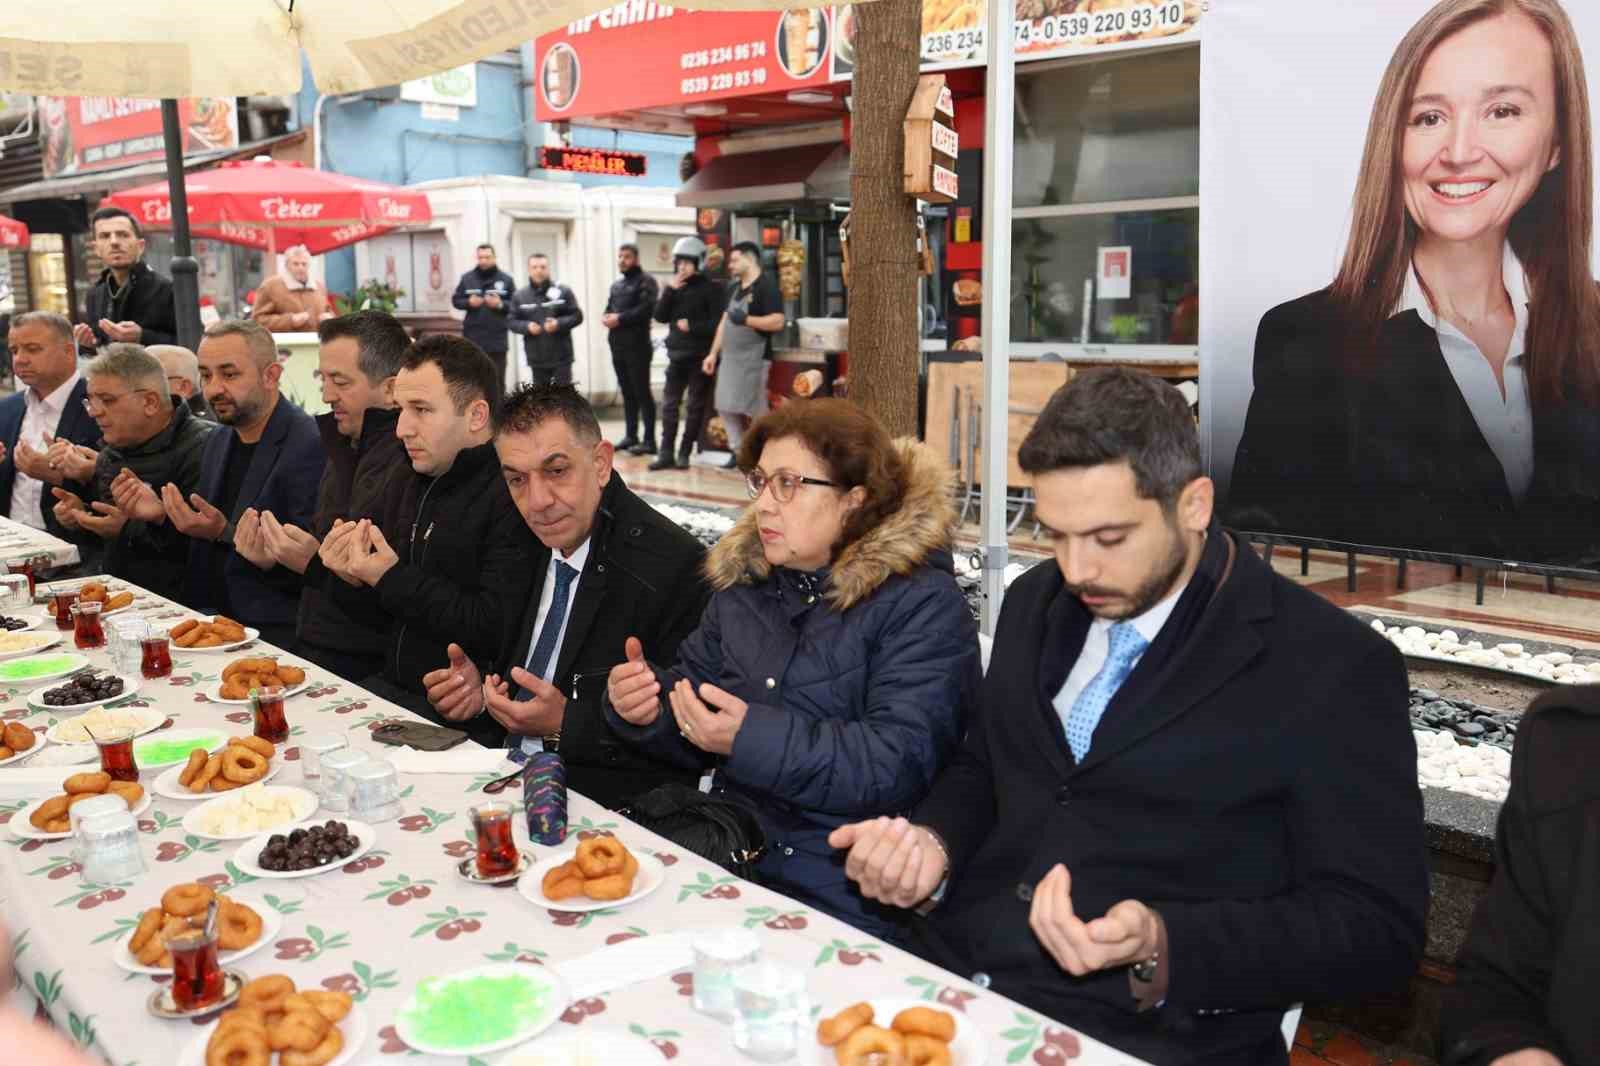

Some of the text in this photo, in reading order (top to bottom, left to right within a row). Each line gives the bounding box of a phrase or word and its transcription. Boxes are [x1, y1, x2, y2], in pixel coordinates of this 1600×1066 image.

[1059, 17, 1089, 37] 539
[1095, 12, 1125, 33] 220
[1131, 8, 1151, 29] 93
[1159, 4, 1180, 25] 10
[927, 30, 983, 52] 236 234
[260, 197, 324, 219] Teker
